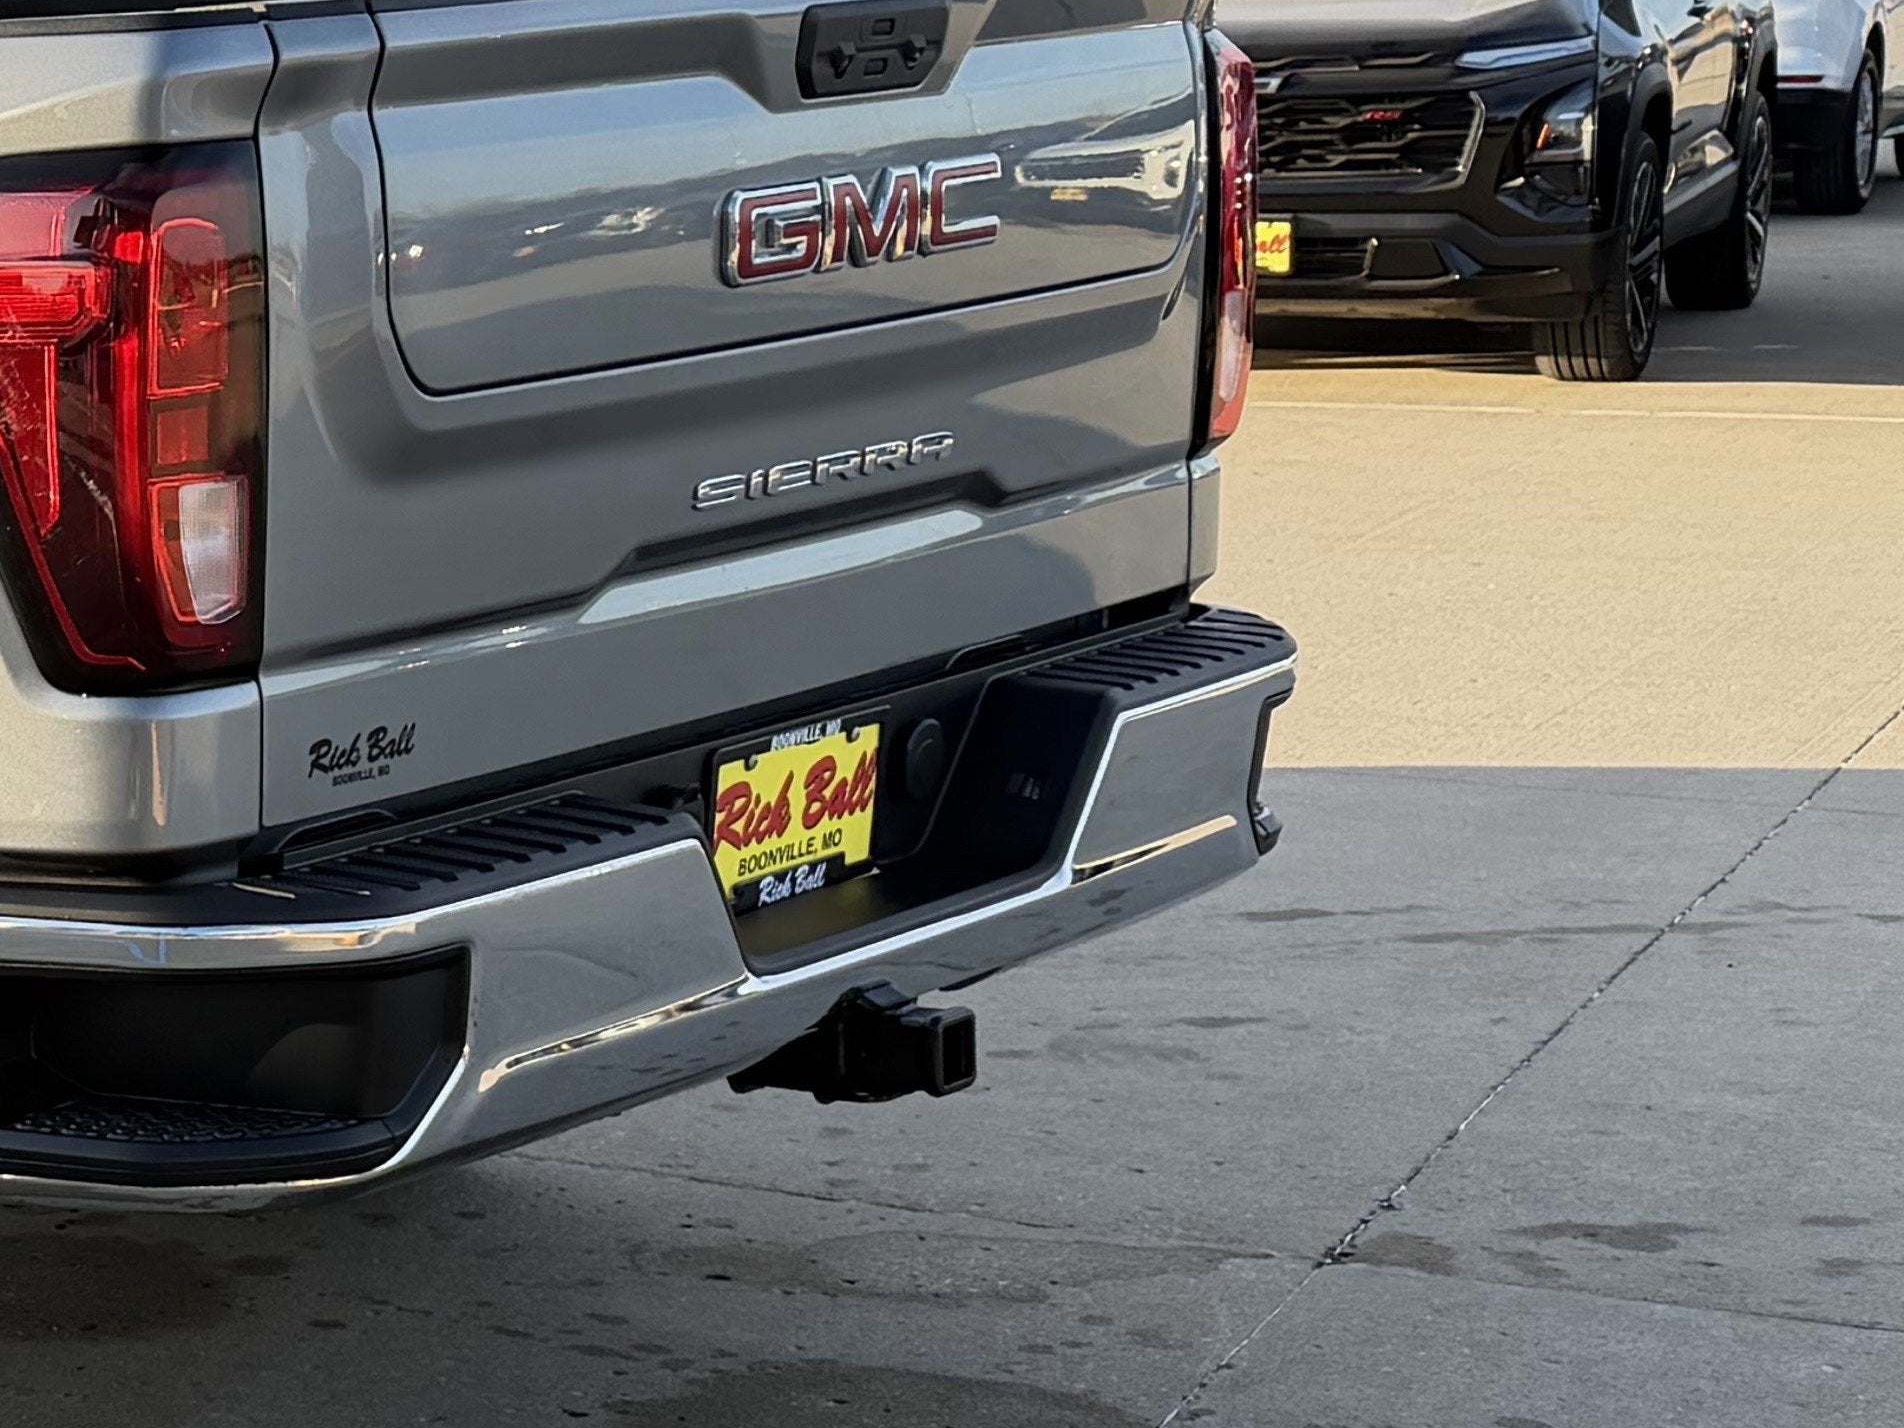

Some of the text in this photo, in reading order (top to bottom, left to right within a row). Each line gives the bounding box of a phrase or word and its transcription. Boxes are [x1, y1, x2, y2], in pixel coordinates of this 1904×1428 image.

[718, 152, 1002, 288] GMC
[692, 430, 954, 511] SIERRA
[308, 722, 416, 778] Rick Ball
[713, 746, 879, 857] Rick Ball
[821, 828, 843, 850] MO
[758, 862, 827, 907] Rick Ball
